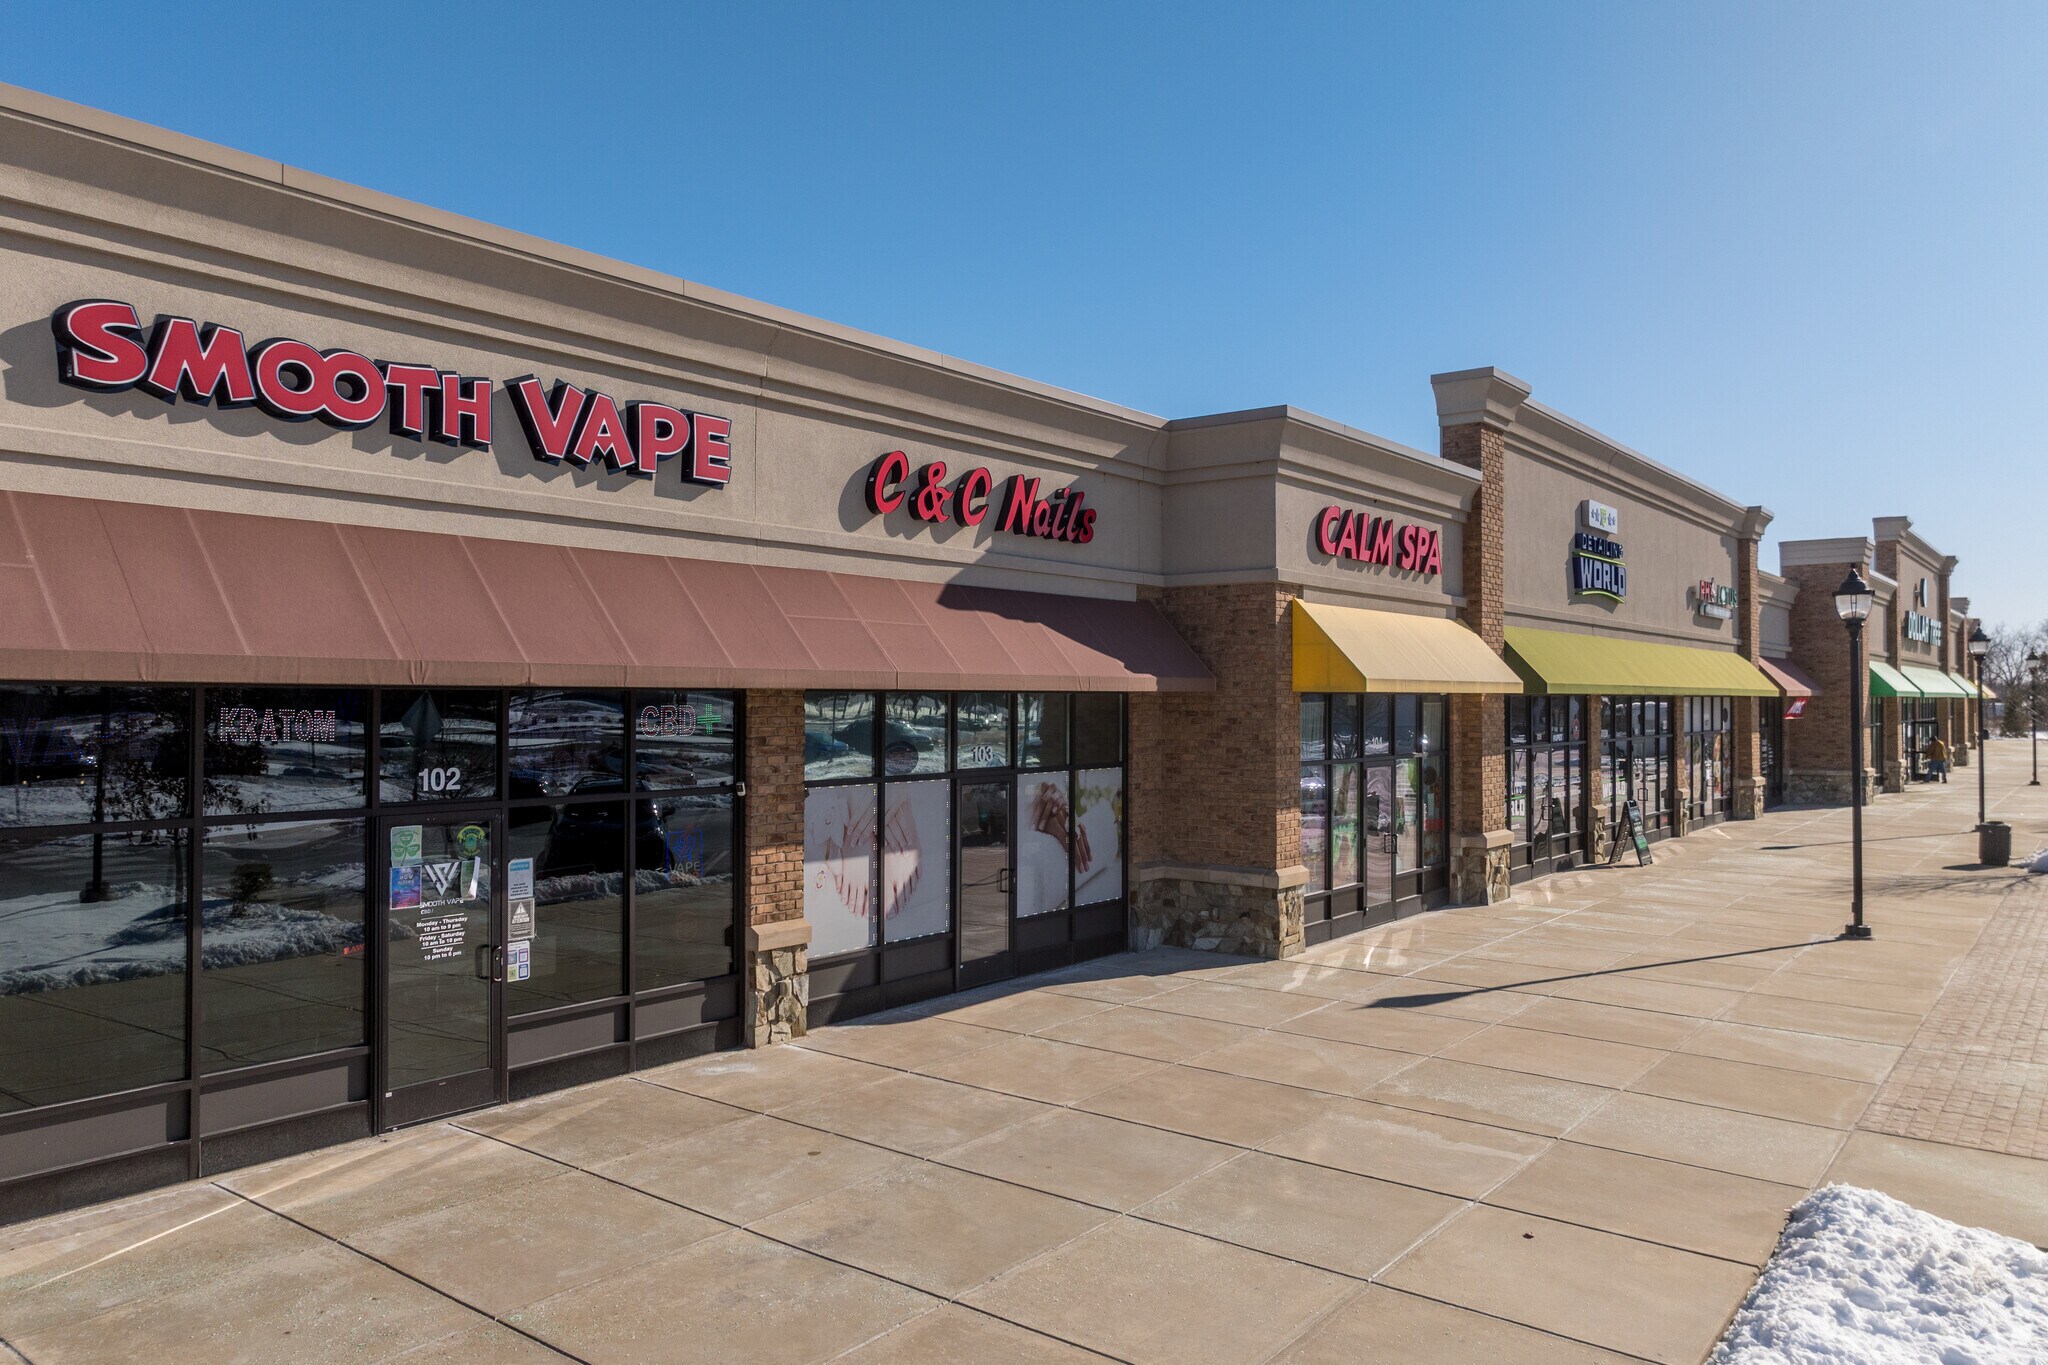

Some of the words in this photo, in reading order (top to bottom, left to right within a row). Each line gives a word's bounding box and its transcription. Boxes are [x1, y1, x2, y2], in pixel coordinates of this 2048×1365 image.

[56, 300, 492, 444] SMOOTH
[508, 375, 731, 484] VAPE
[867, 451, 909, 515] C
[909, 461, 952, 523] &
[954, 467, 992, 527] C
[997, 473, 1097, 544] Nails
[1316, 505, 1394, 567] CALM
[1398, 523, 1442, 575] SPA
[1577, 533, 1624, 559] DETAILING
[1576, 557, 1626, 597] WORLD
[1906, 611, 1929, 644] DOLLAR
[1930, 619, 1942, 647] TREE
[219, 707, 336, 742] KRATOM
[971, 745, 993, 762] 103
[419, 767, 461, 791] 102
[670, 861, 701, 873] VAPE
[420, 899, 445, 908] SMOOTH
[446, 897, 464, 905] VAPE
[416, 920, 438, 928] Monday
[442, 916, 468, 924] Thursday
[441, 931, 466, 939] Saturday
